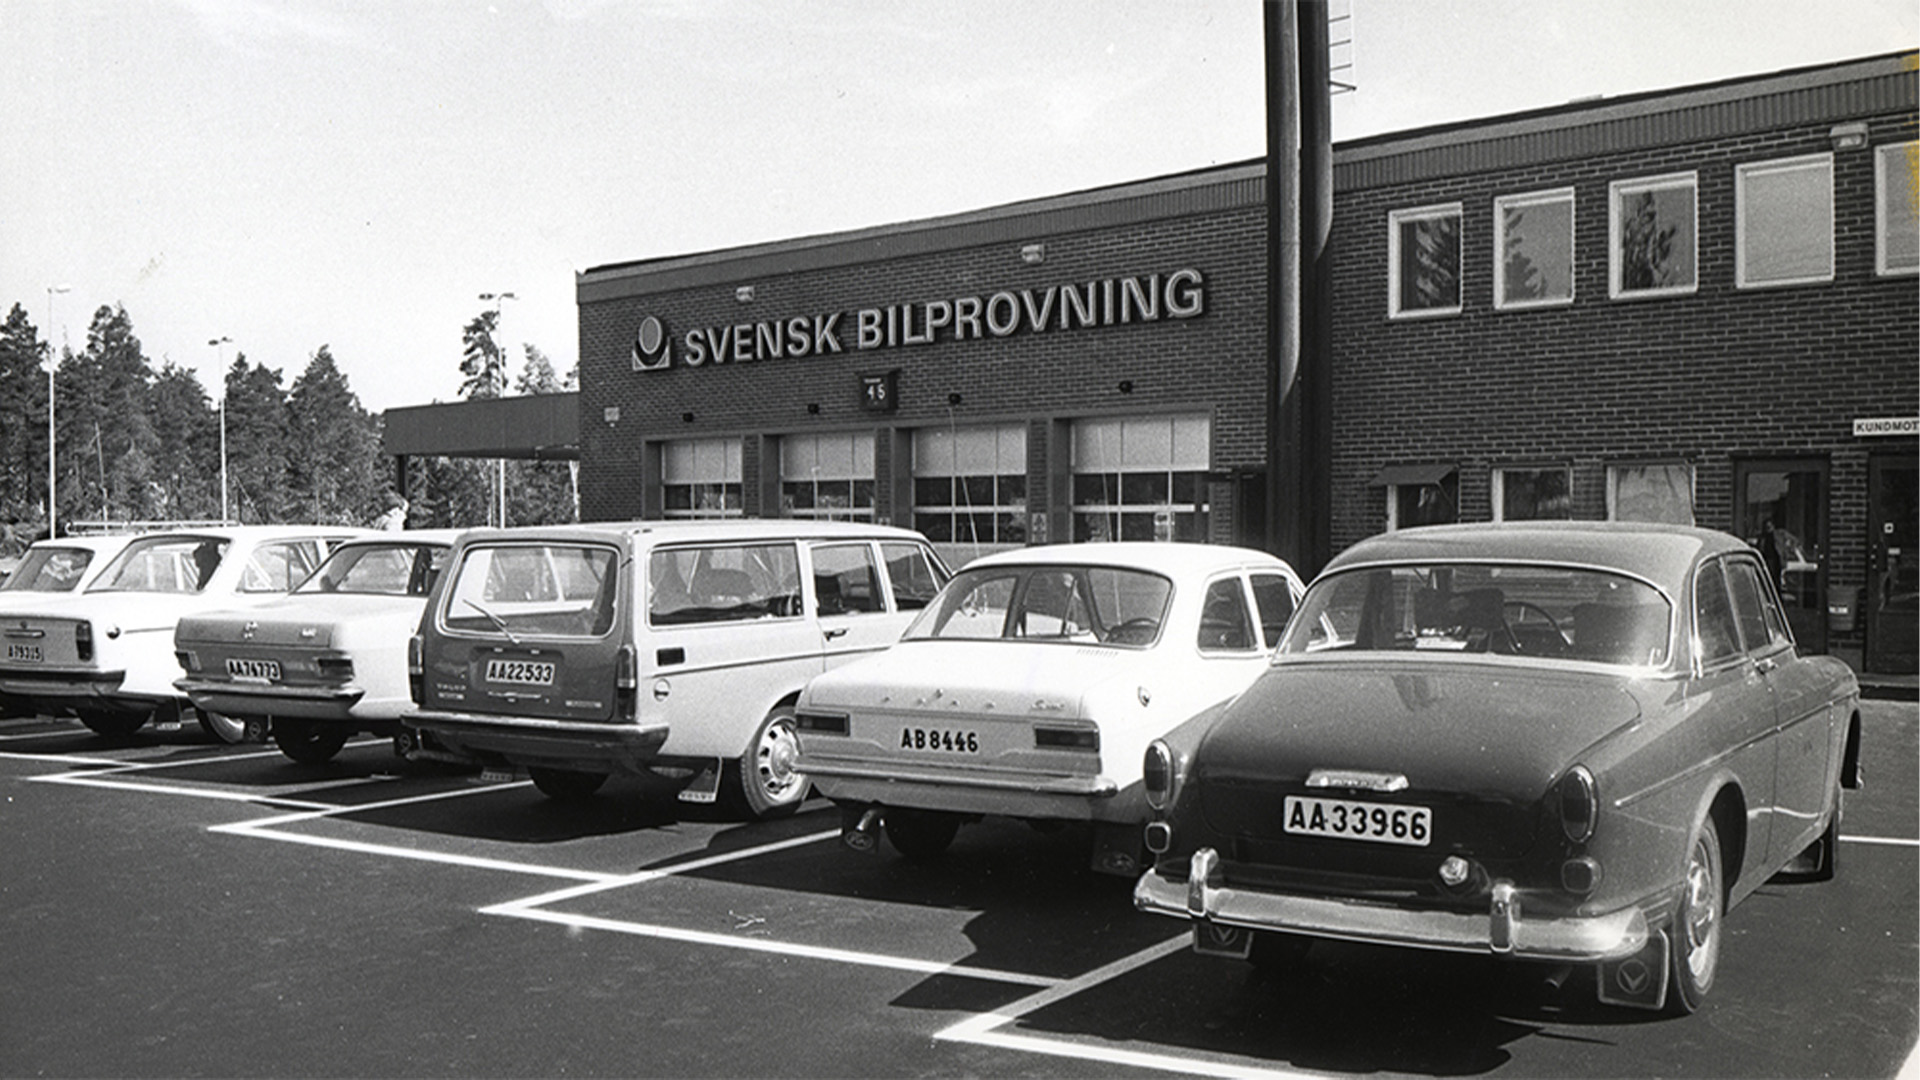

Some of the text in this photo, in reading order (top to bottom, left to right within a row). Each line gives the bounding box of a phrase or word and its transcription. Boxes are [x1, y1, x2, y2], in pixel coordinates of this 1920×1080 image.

[684, 268, 1203, 366] SVENSK BILPROVNING
[488, 662, 553, 683] AA22533
[901, 728, 979, 753] AB8446
[1289, 801, 1426, 840] AA33966
